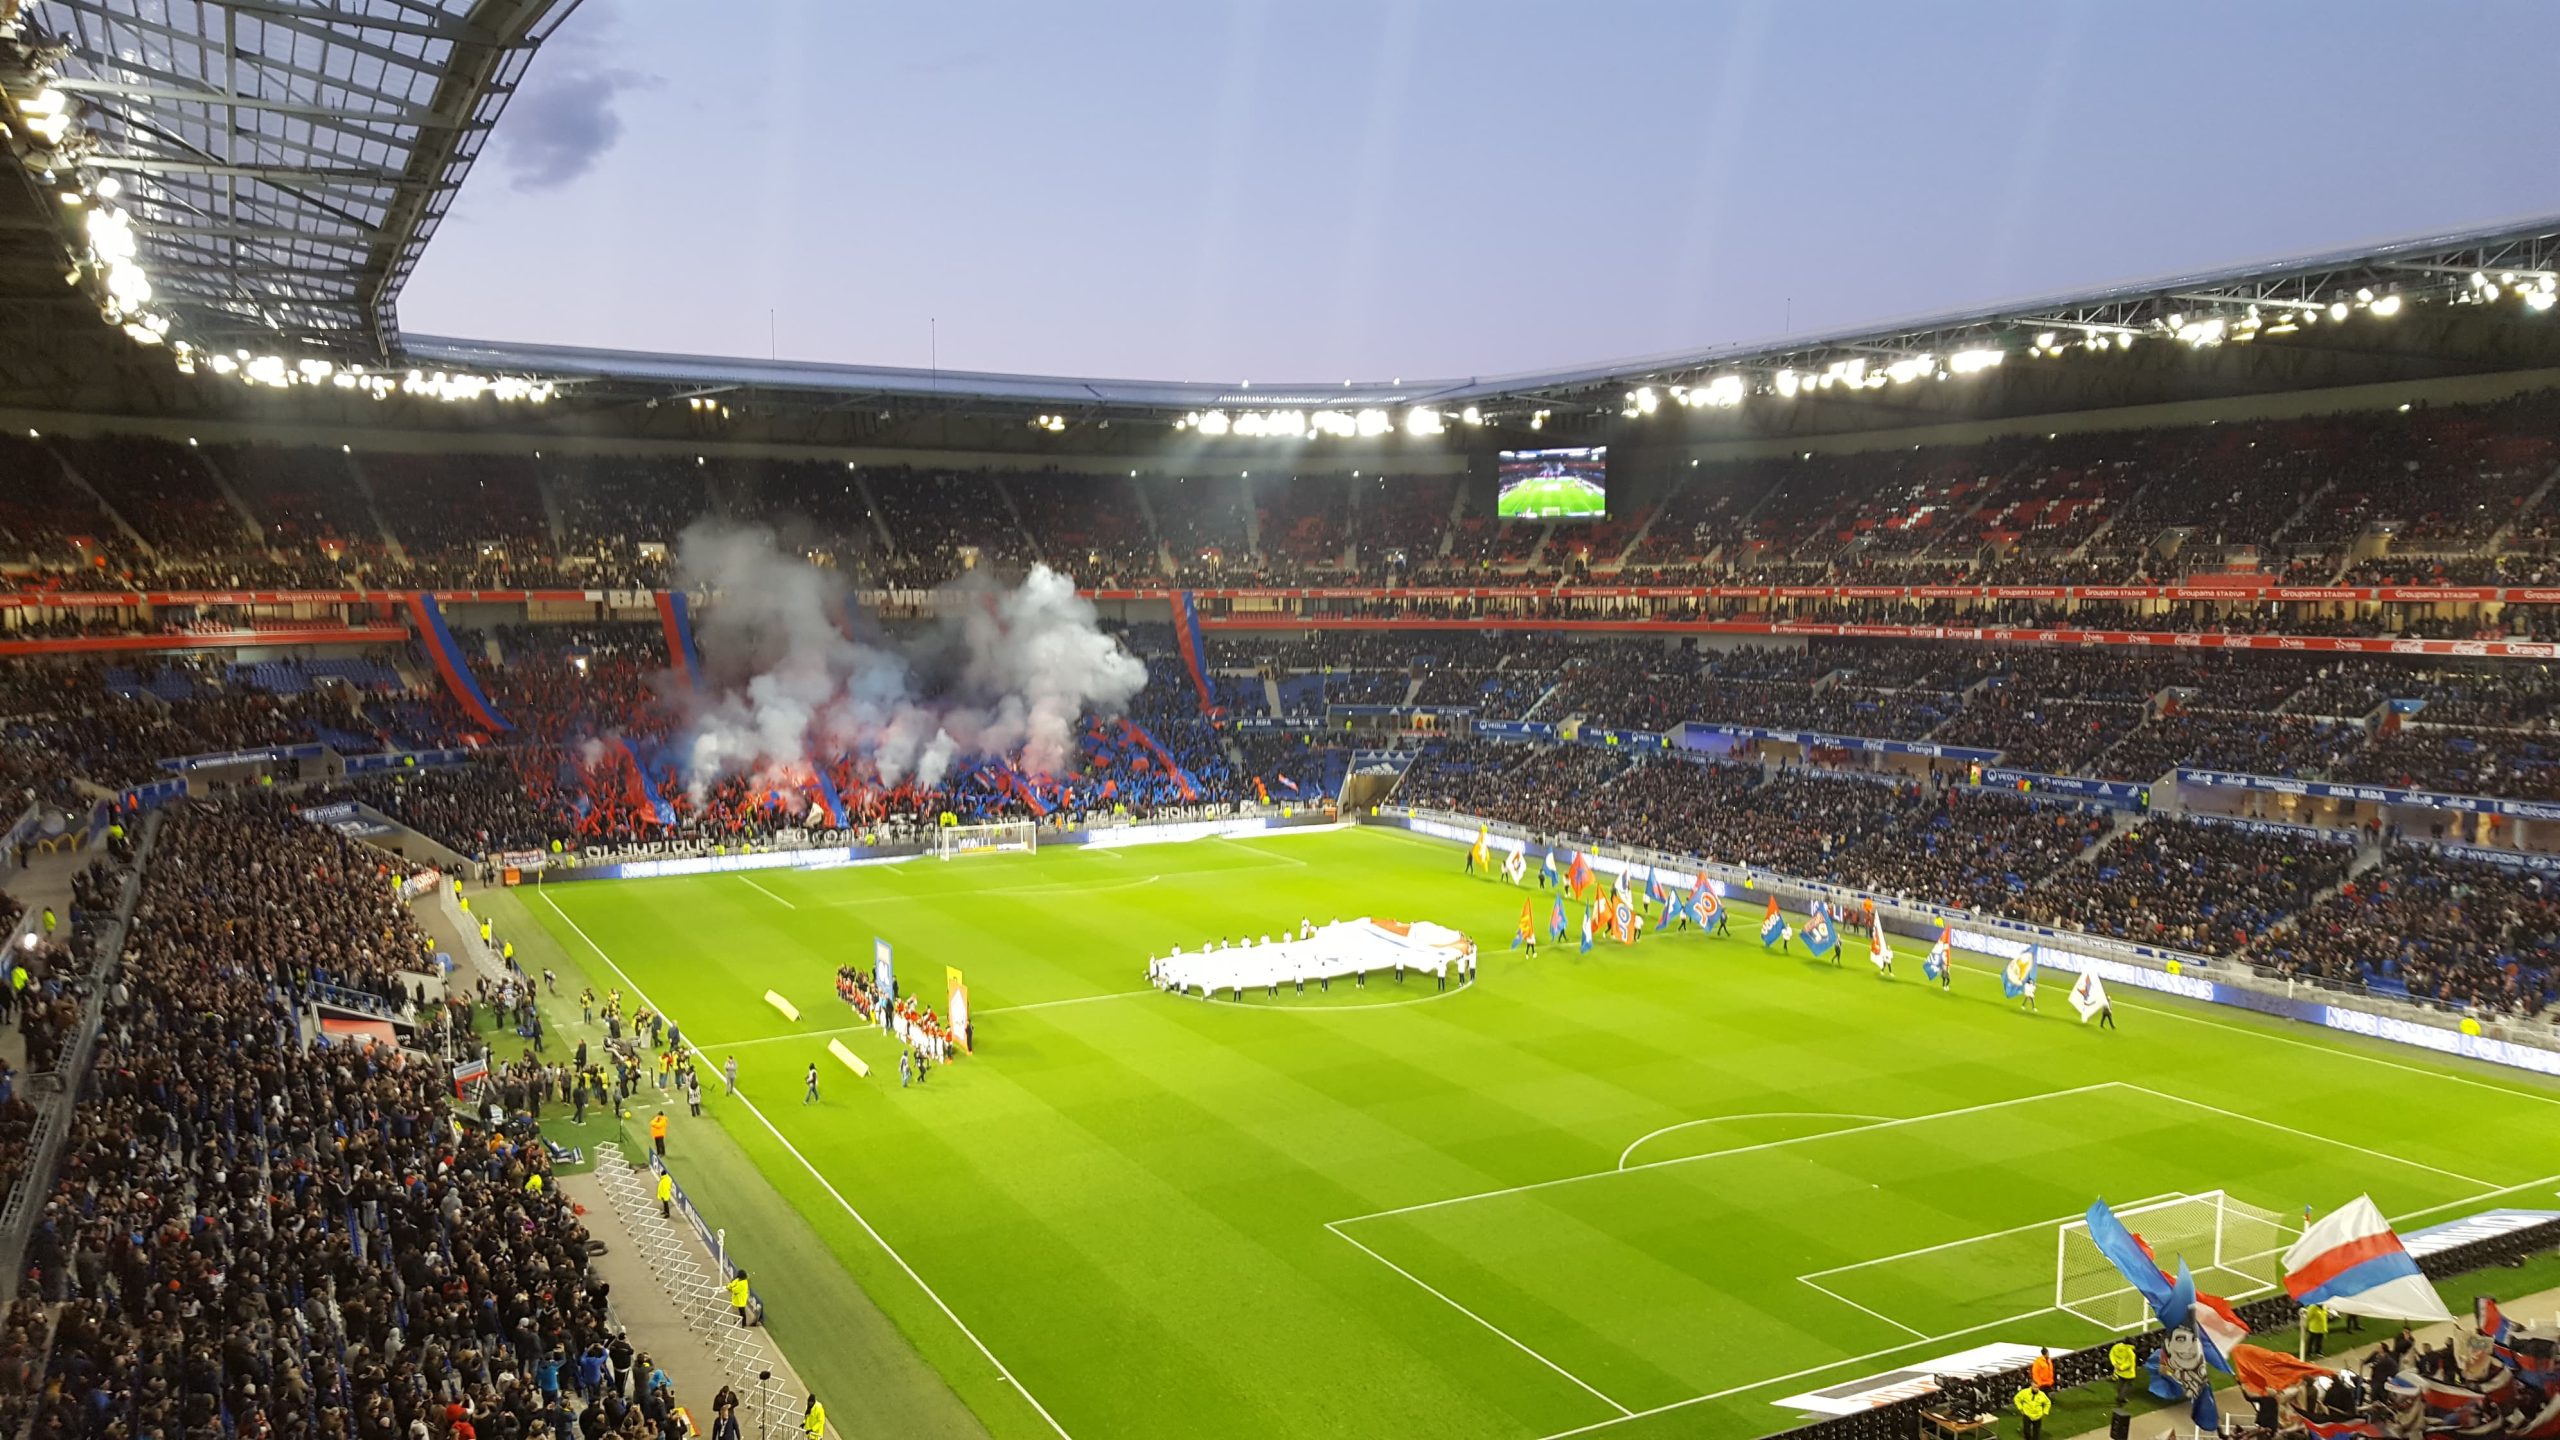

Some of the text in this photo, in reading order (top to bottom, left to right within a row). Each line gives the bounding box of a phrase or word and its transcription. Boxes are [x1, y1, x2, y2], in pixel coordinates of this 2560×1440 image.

[2085, 588, 2147, 597] Groupama STADIUM
[2177, 588, 2246, 598] Groupama STADIUM
[2280, 589, 2356, 599] Groupama STADIUM
[2394, 589, 2480, 599] Groupama STADIUM
[1910, 628, 1935, 638] Orange
[1947, 629, 1973, 639] Orange
[2507, 644, 2553, 657] Orange
[1907, 743, 1933, 755] Orange
[316, 803, 352, 818] HYUNDAI
[1950, 928, 1986, 953] NOUS
[2135, 966, 2214, 1001] LYONNAIS
[2326, 1005, 2378, 1036] NOUS
